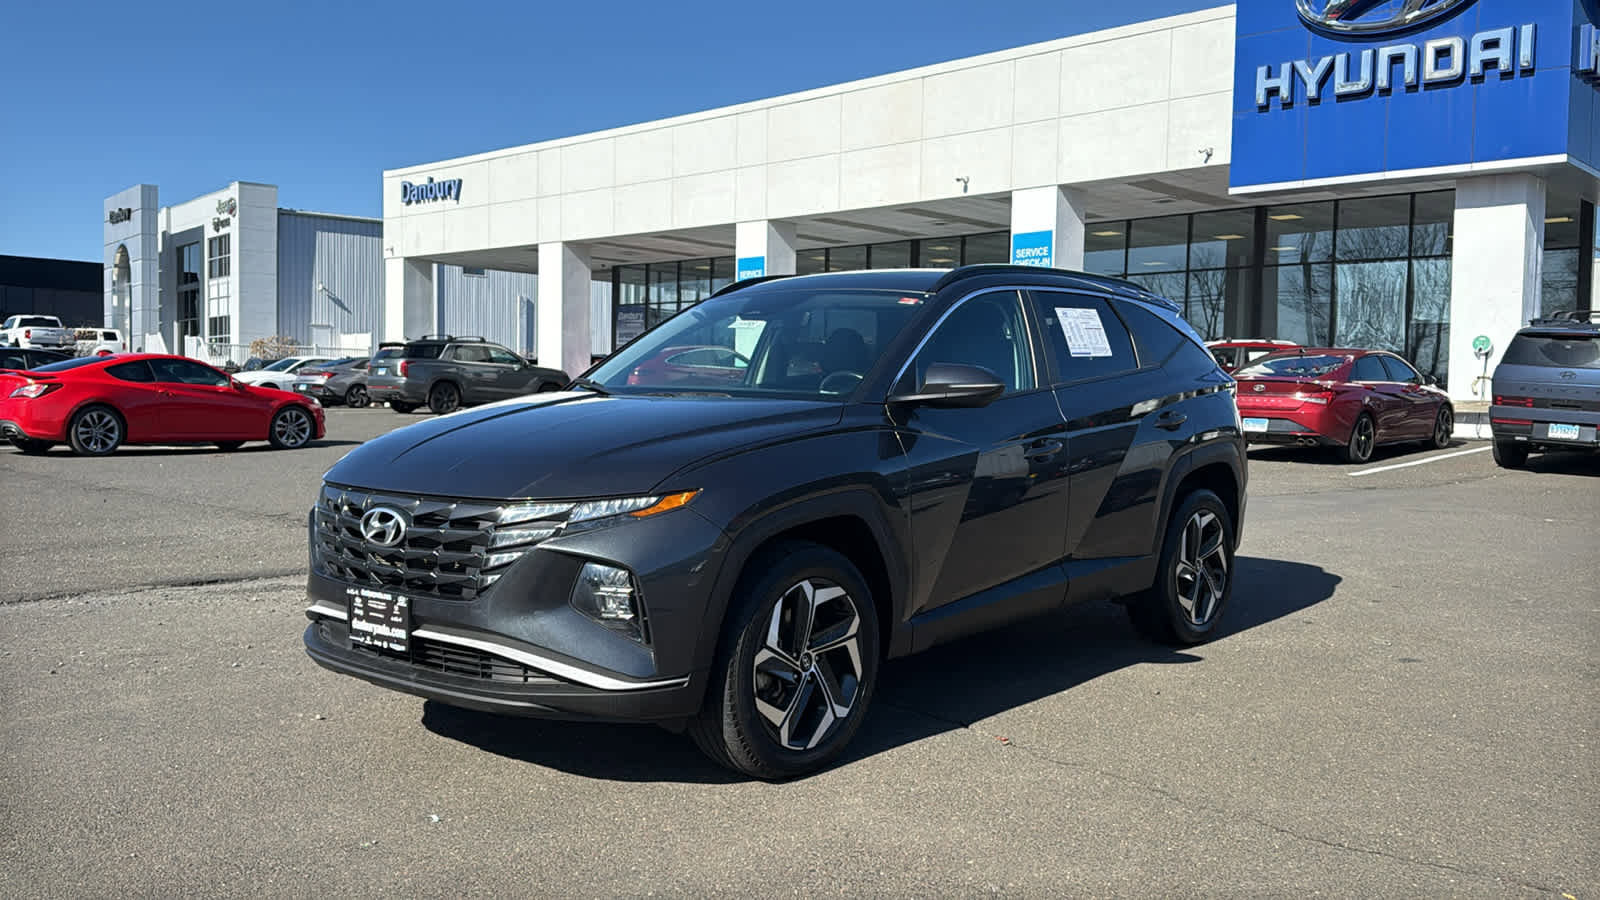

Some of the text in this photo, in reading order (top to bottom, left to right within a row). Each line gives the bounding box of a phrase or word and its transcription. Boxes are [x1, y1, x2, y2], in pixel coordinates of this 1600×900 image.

[1256, 23, 1537, 110] HYUNDAI
[401, 176, 462, 205] Danbury
[1016, 246, 1049, 258] SERVICE
